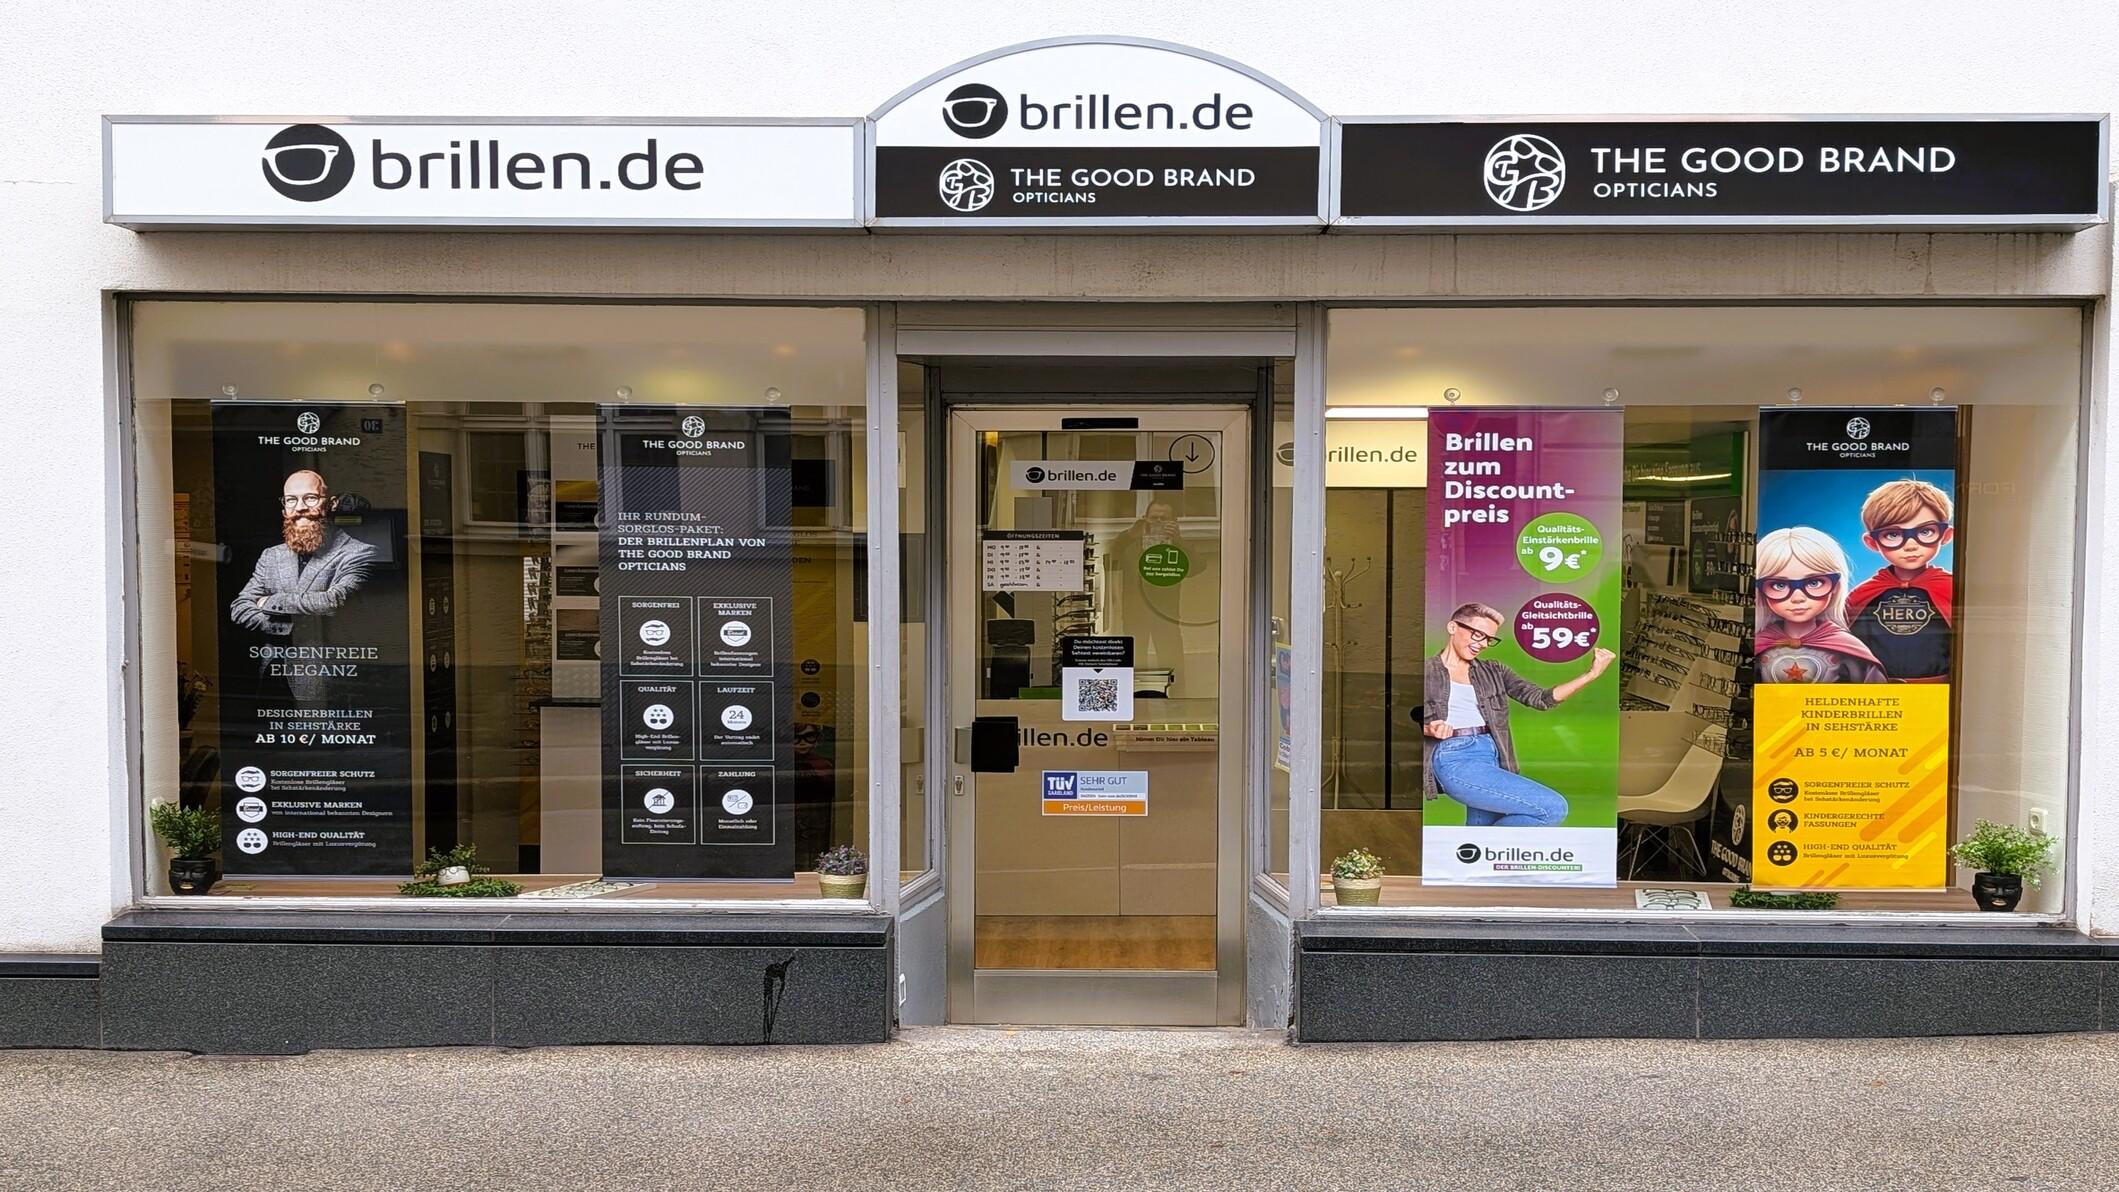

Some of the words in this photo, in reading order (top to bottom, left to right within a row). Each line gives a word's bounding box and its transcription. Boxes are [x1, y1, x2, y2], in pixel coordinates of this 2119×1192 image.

[1020, 93, 1253, 130] brillen.de
[372, 139, 704, 191] brillen.de
[1591, 147, 1667, 174] THE
[1682, 147, 1804, 174] GOOD
[1820, 147, 1956, 174] BRAND
[1011, 168, 1062, 187] THE
[1082, 168, 1154, 187] GOOD
[1164, 168, 1255, 187] BRAND
[1593, 182, 1718, 198] OPTICIANS
[1012, 192, 1096, 204] OPTICIANS
[258, 436, 280, 445] THE
[283, 436, 318, 445] GOOD
[321, 437, 361, 446] BRAND
[642, 440, 665, 449] THE
[668, 441, 703, 449] GOOD
[706, 441, 745, 450] BRAND
[1445, 432, 1533, 452] Brillen
[1806, 442, 1829, 451] THE
[1832, 442, 1868, 451] GOOD
[1872, 442, 1910, 451] BRAND
[1444, 461, 1501, 476] zum
[1048, 467, 1117, 482] brillen.de
[1444, 480, 1575, 500] Discount-
[618, 512, 640, 521] IHR
[645, 512, 707, 522] RUNDUM-
[1444, 504, 1510, 528] preis
[618, 525, 724, 534] SORGLOS-PAKET:
[1537, 525, 1585, 535] Qualitäts-
[618, 537, 643, 546] DER
[647, 537, 734, 547] BRILLENPLAN
[739, 538, 766, 547] VON
[1522, 535, 1599, 546] Einstärkenbrille
[618, 550, 644, 558] THE
[648, 550, 684, 559] GOOD
[687, 550, 732, 559] BRAND
[1521, 547, 1534, 556] ab
[618, 562, 687, 571] OPTICIANS
[1534, 600, 1582, 610] Qualitäts-
[1522, 611, 1593, 621] Gleitsichtbrille
[1882, 606, 1928, 621] HERO
[1521, 622, 1534, 630] ab
[249, 646, 378, 660] SORGENFREIE
[270, 664, 358, 678] ELEGANZ
[1805, 698, 1900, 706] HELDENHAFTE
[257, 708, 373, 719] DESIGNERBRILLEN
[729, 710, 744, 720] 24
[1801, 711, 1903, 719] KINDERBRILLEN
[269, 721, 283, 730] IN
[287, 720, 361, 731] SEHSTÄRKE
[1806, 723, 1821, 731] IN
[1824, 722, 1898, 732] SEHSTÄRKE
[255, 734, 276, 744] AB
[281, 734, 296, 744] 10
[321, 734, 376, 745] MONAT
[1794, 748, 1815, 758] AB
[1820, 748, 1827, 758] 5
[1853, 748, 1909, 758] MONAT
[270, 770, 338, 778] SORGENFREIER
[340, 770, 376, 778] SCHUTZ
[1080, 777, 1106, 785] SEHR
[1108, 777, 1127, 785] GUT
[272, 801, 321, 809] EXKLUSIVE
[1063, 804, 1127, 813] Preis/Leistung
[272, 831, 318, 839] HIGH-END
[320, 831, 365, 840] QUALITÄT
[1485, 846, 1574, 863] brillen.de
